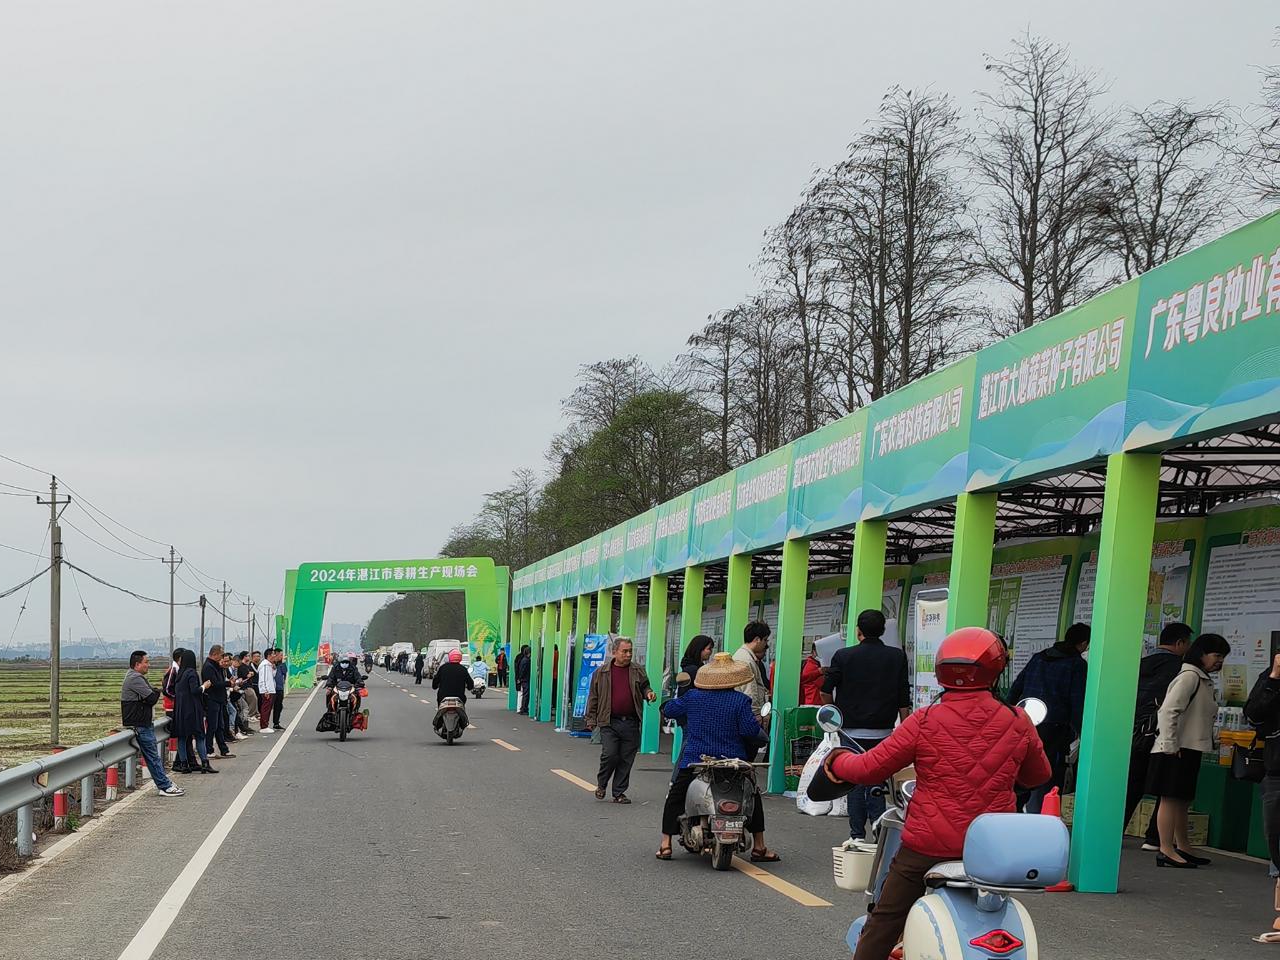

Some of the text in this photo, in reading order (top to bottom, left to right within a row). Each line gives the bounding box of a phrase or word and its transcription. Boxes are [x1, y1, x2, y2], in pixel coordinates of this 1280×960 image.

[978, 317, 1125, 419] 湛江市大地蔬菜种子有限公司
[310, 565, 478, 582] 2024年湛江市春耕生产现场会
